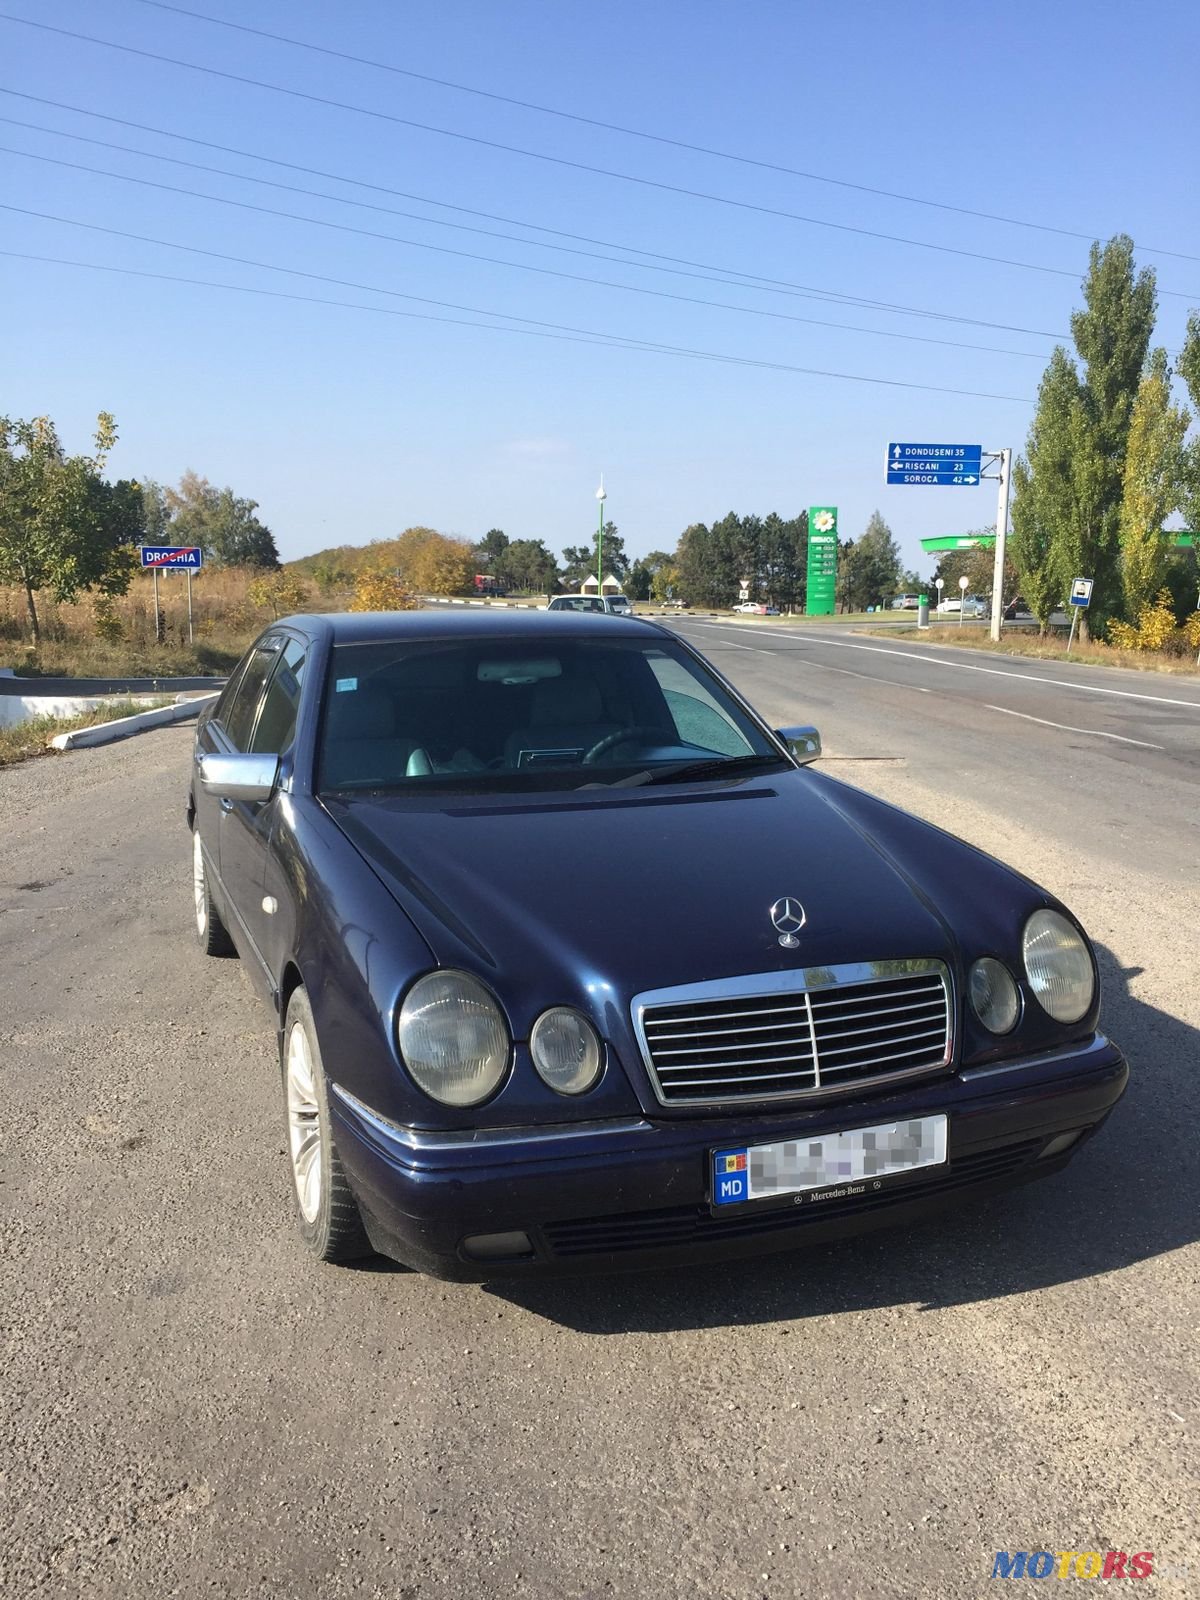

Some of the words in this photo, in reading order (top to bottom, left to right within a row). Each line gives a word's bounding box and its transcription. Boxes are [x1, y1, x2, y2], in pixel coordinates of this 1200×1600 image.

[905, 448, 953, 456] DONDUSENI
[954, 449, 965, 457] 35
[905, 462, 939, 470] RISCANI
[953, 463, 964, 471] 23
[904, 475, 938, 483] SOROCA
[146, 552, 196, 563] DROCHIA
[721, 1180, 742, 1197] MD
[811, 1184, 865, 1201] Mercedes-Benz
